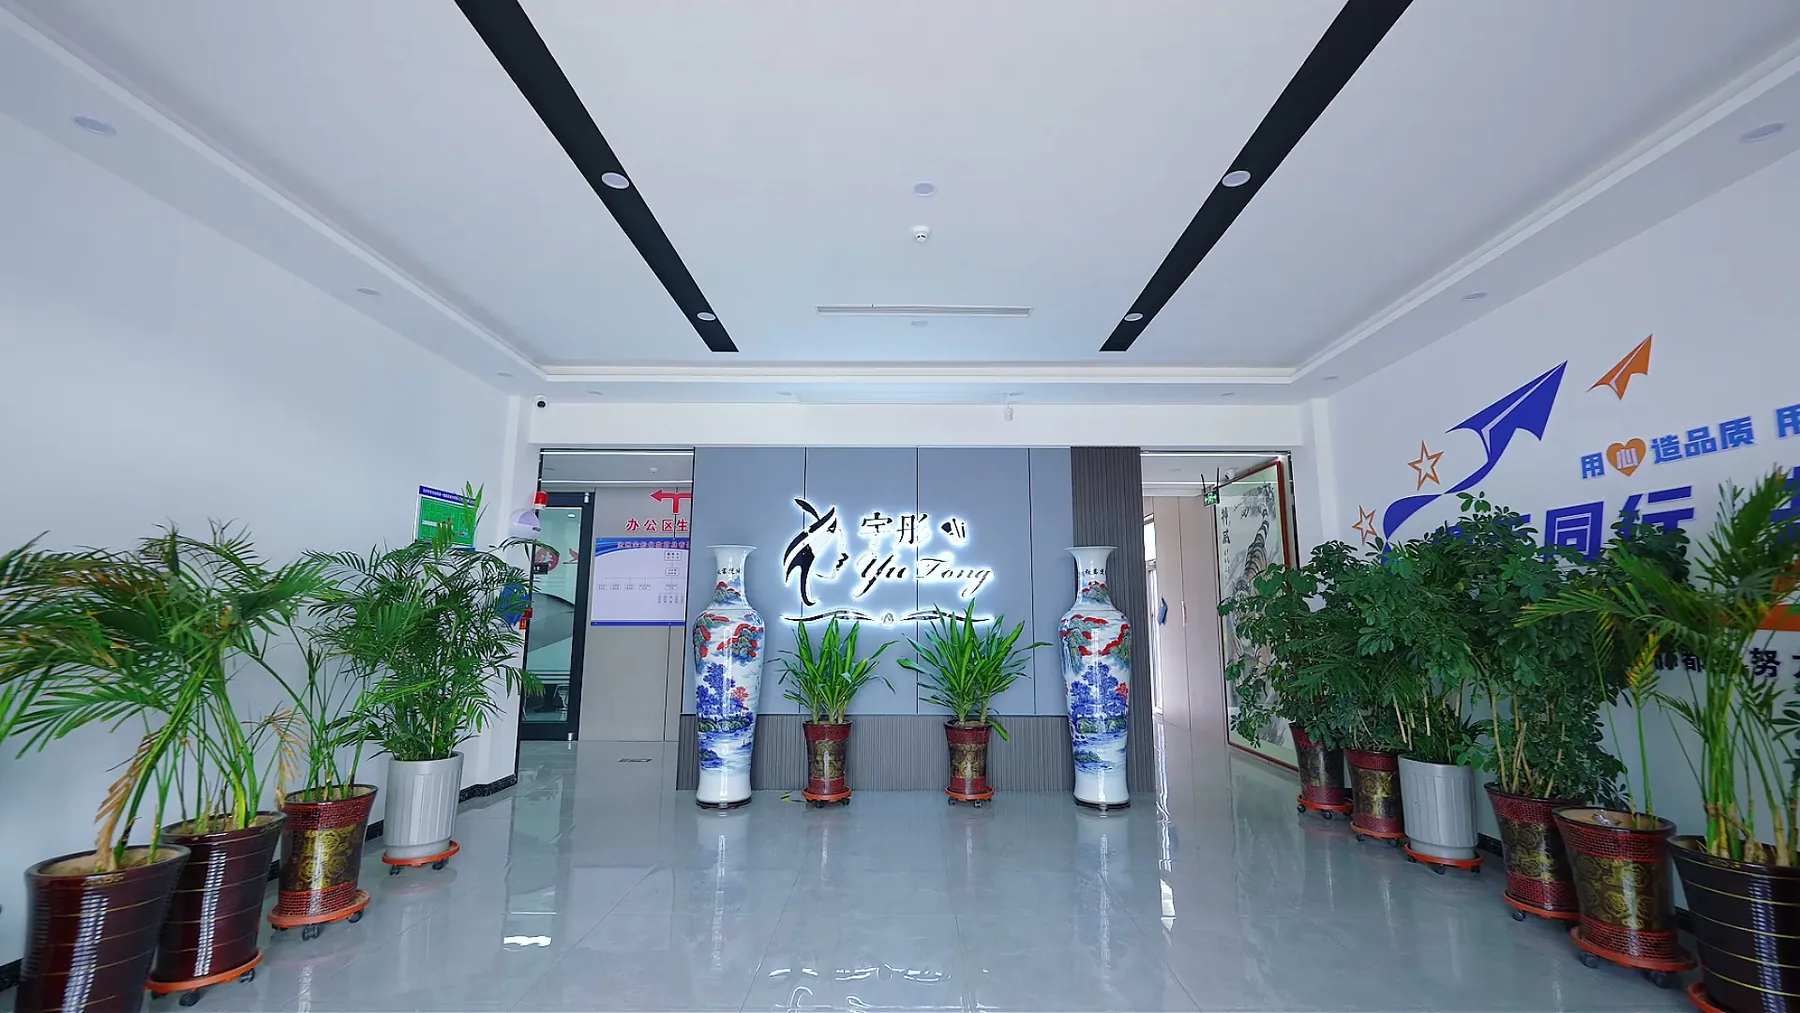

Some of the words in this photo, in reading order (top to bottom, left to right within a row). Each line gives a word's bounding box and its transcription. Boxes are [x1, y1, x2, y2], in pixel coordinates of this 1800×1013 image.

[1581, 416, 1755, 479] 用心造品质
